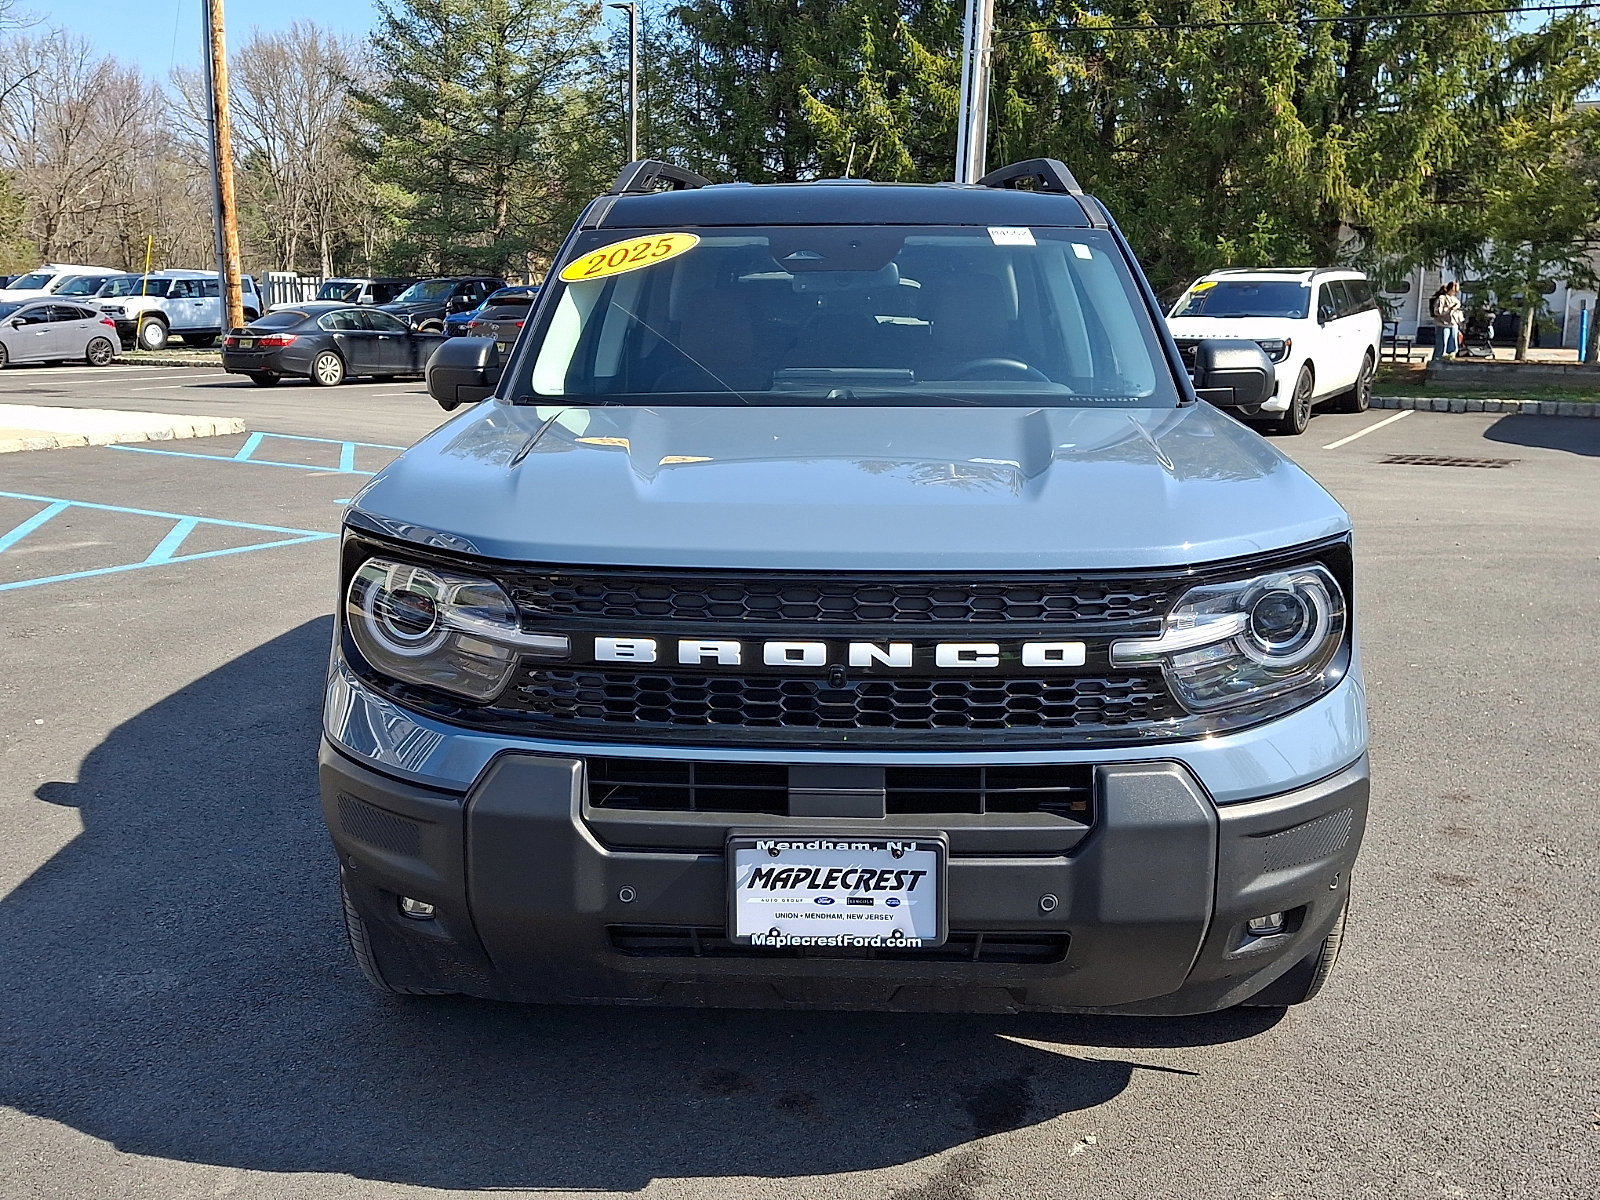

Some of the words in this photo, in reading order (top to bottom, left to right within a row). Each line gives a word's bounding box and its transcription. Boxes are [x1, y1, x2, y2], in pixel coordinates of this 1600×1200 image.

[584, 237, 674, 276] 2025
[594, 637, 1086, 668] BRONCO
[756, 840, 878, 851] Mendham,
[886, 842, 917, 851] NJ
[747, 867, 927, 892] MAPLECREST
[775, 912, 799, 920] UNION
[805, 913, 845, 921] MENDHAM,
[846, 913, 864, 921] NEW
[865, 914, 894, 922] JERSEY
[751, 934, 922, 949] MaplecrestFord.com
